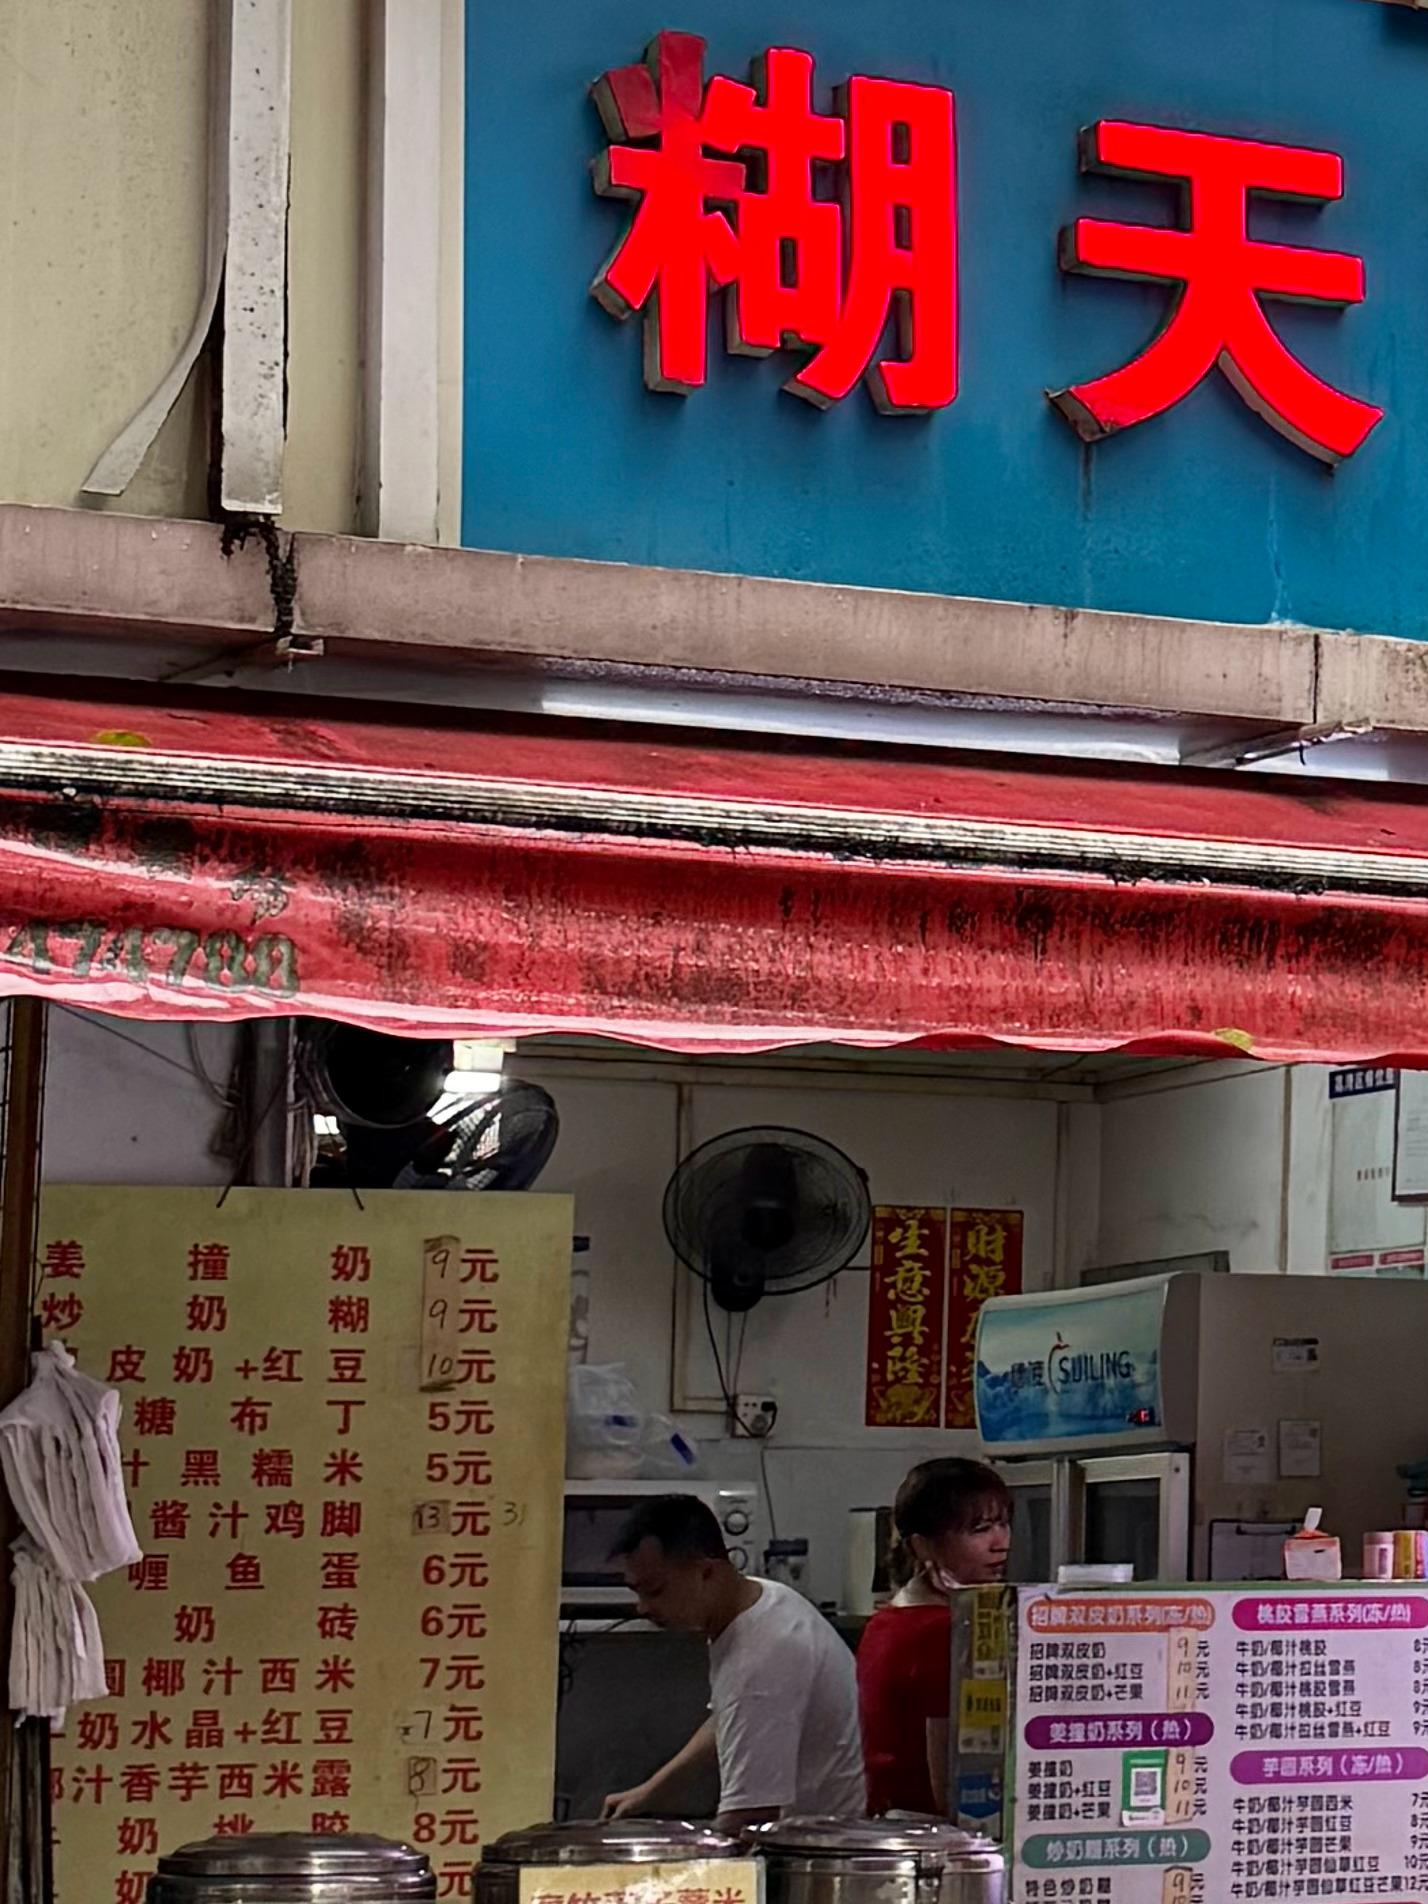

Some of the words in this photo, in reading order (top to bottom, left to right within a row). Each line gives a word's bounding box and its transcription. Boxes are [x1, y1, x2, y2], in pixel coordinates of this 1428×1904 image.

[41, 1241, 371, 1283] 姜撞奶
[430, 1246, 499, 1283] 9元
[41, 1293, 369, 1333] 炒奶糊
[428, 1296, 497, 1334] 9元
[961, 1224, 1007, 1384] 財源
[60, 1343, 367, 1385] 皮奶+红豆
[426, 1348, 496, 1385] 10元
[1058, 1350, 1132, 1384] SUILING
[134, 1397, 366, 1437] 糖布丁
[428, 1400, 495, 1436] 5元
[122, 1448, 364, 1488] 汁黑糯米
[426, 1451, 492, 1487] 5元
[128, 1500, 362, 1540] 酱汁鸡脚
[128, 1552, 360, 1592] 喱鱼蛋
[422, 1554, 488, 1589] 6元
[174, 1604, 359, 1644] 奶砖
[420, 1605, 487, 1639] 6元
[103, 1657, 355, 1698] 圆椰汁西米
[419, 1657, 485, 1691] 7元
[52, 1708, 353, 1751] 奶水晶+红豆
[408, 1757, 481, 1795] 8元
[54, 1811, 350, 1856] 奶桃胶
[412, 1809, 480, 1847] 8元
